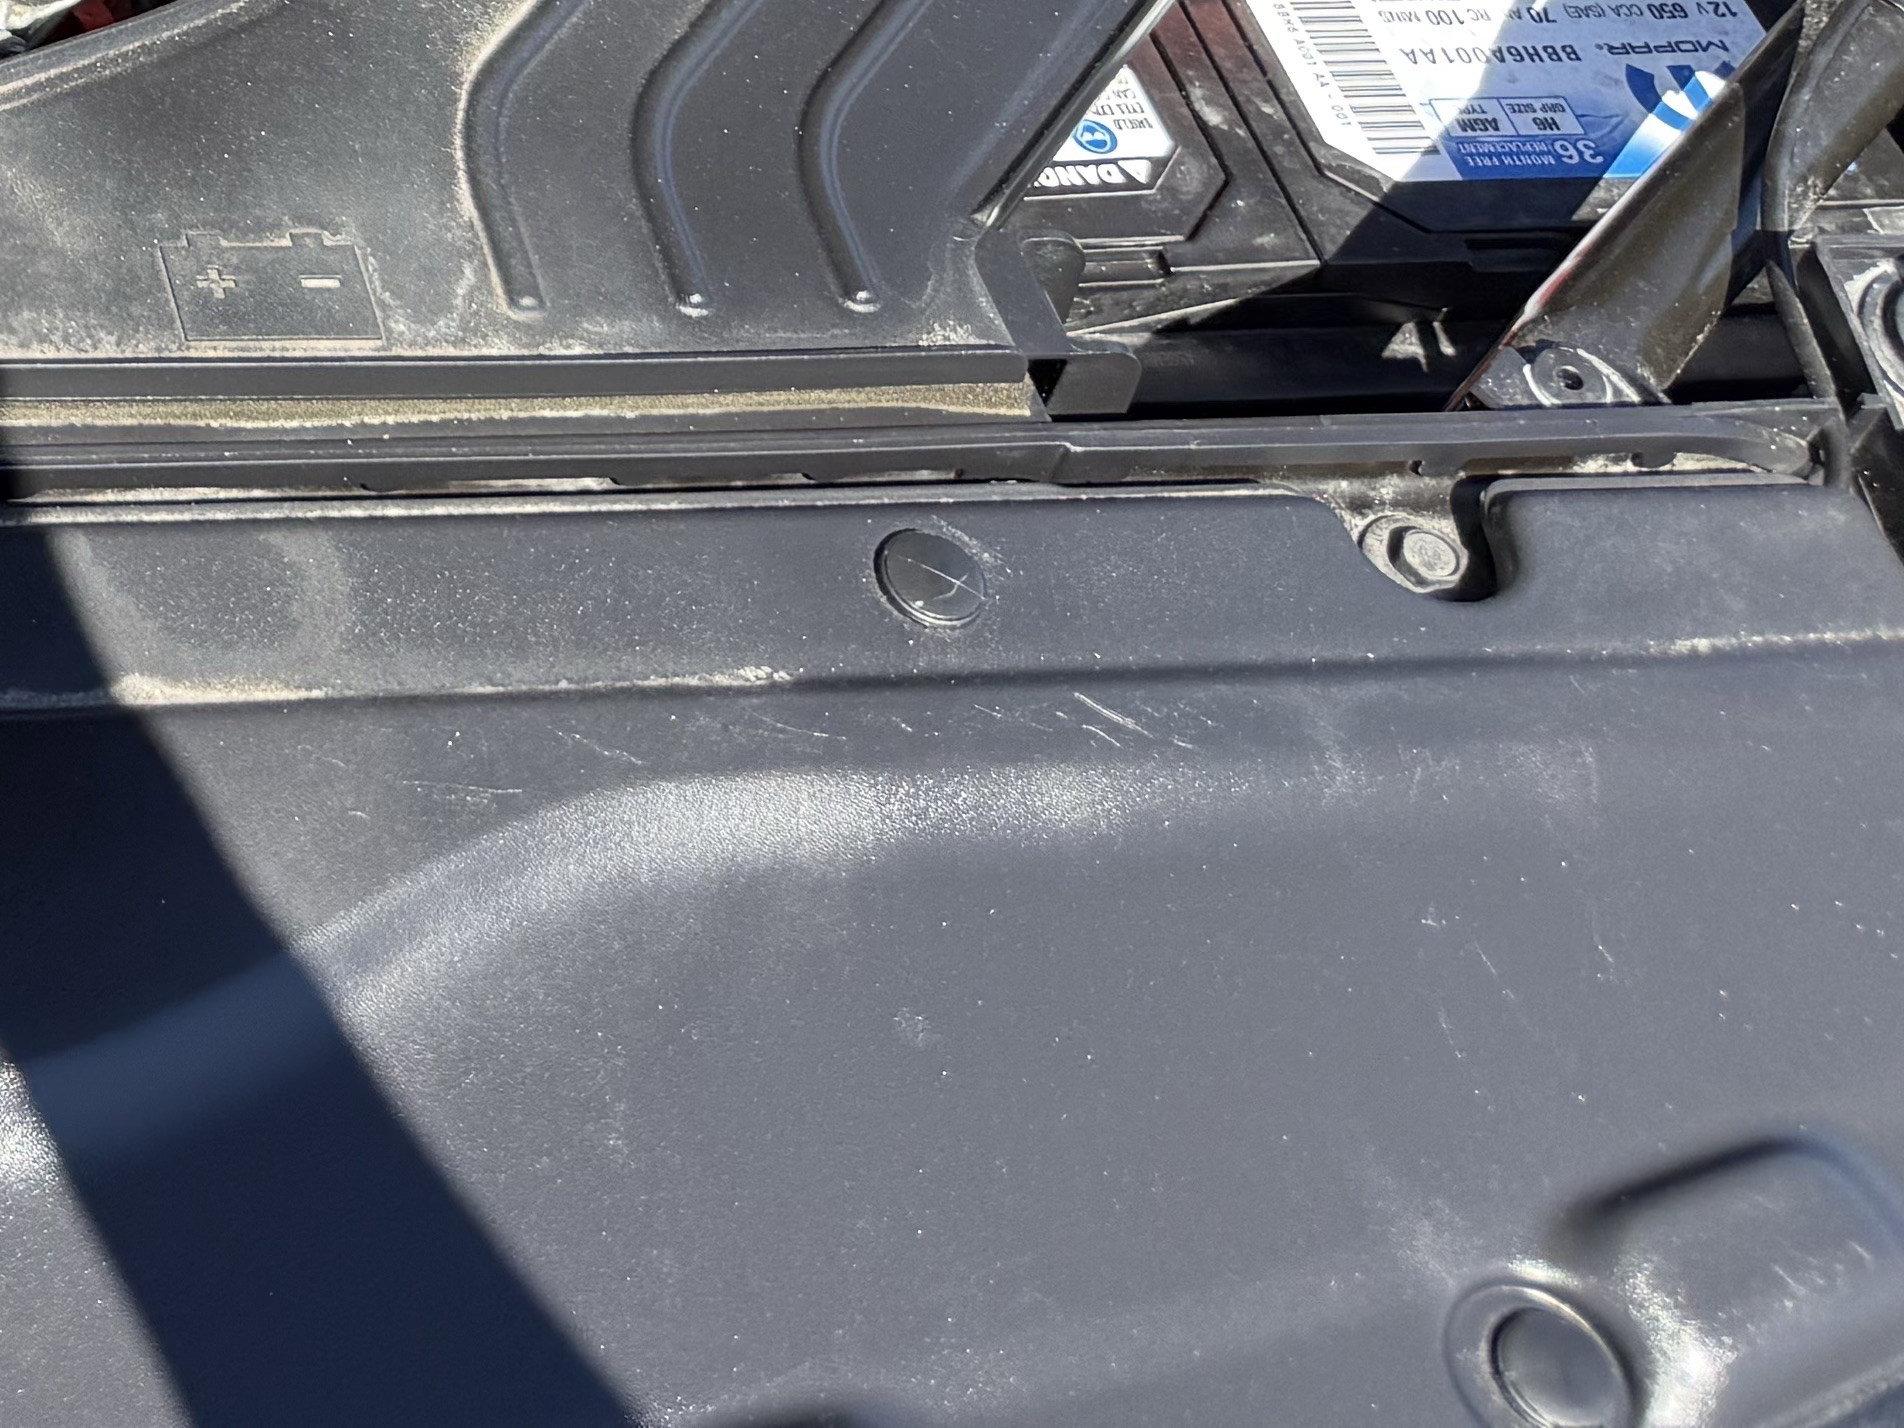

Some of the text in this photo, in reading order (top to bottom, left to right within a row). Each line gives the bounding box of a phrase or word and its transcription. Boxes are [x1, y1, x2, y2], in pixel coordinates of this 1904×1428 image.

[1425, 10, 1464, 25] 100
[1528, 7, 1557, 24] 70
[1607, 3, 1642, 20] CCA
[1645, 2, 1688, 21] 650
[1399, 43, 1581, 65] BBH6A001AA
[1506, 103, 1535, 114] SIZE
[1456, 118, 1499, 132] AGM
[1532, 117, 1561, 131] H6
[1553, 139, 1603, 164] 36
[1464, 155, 1555, 166] MONTH FREE
